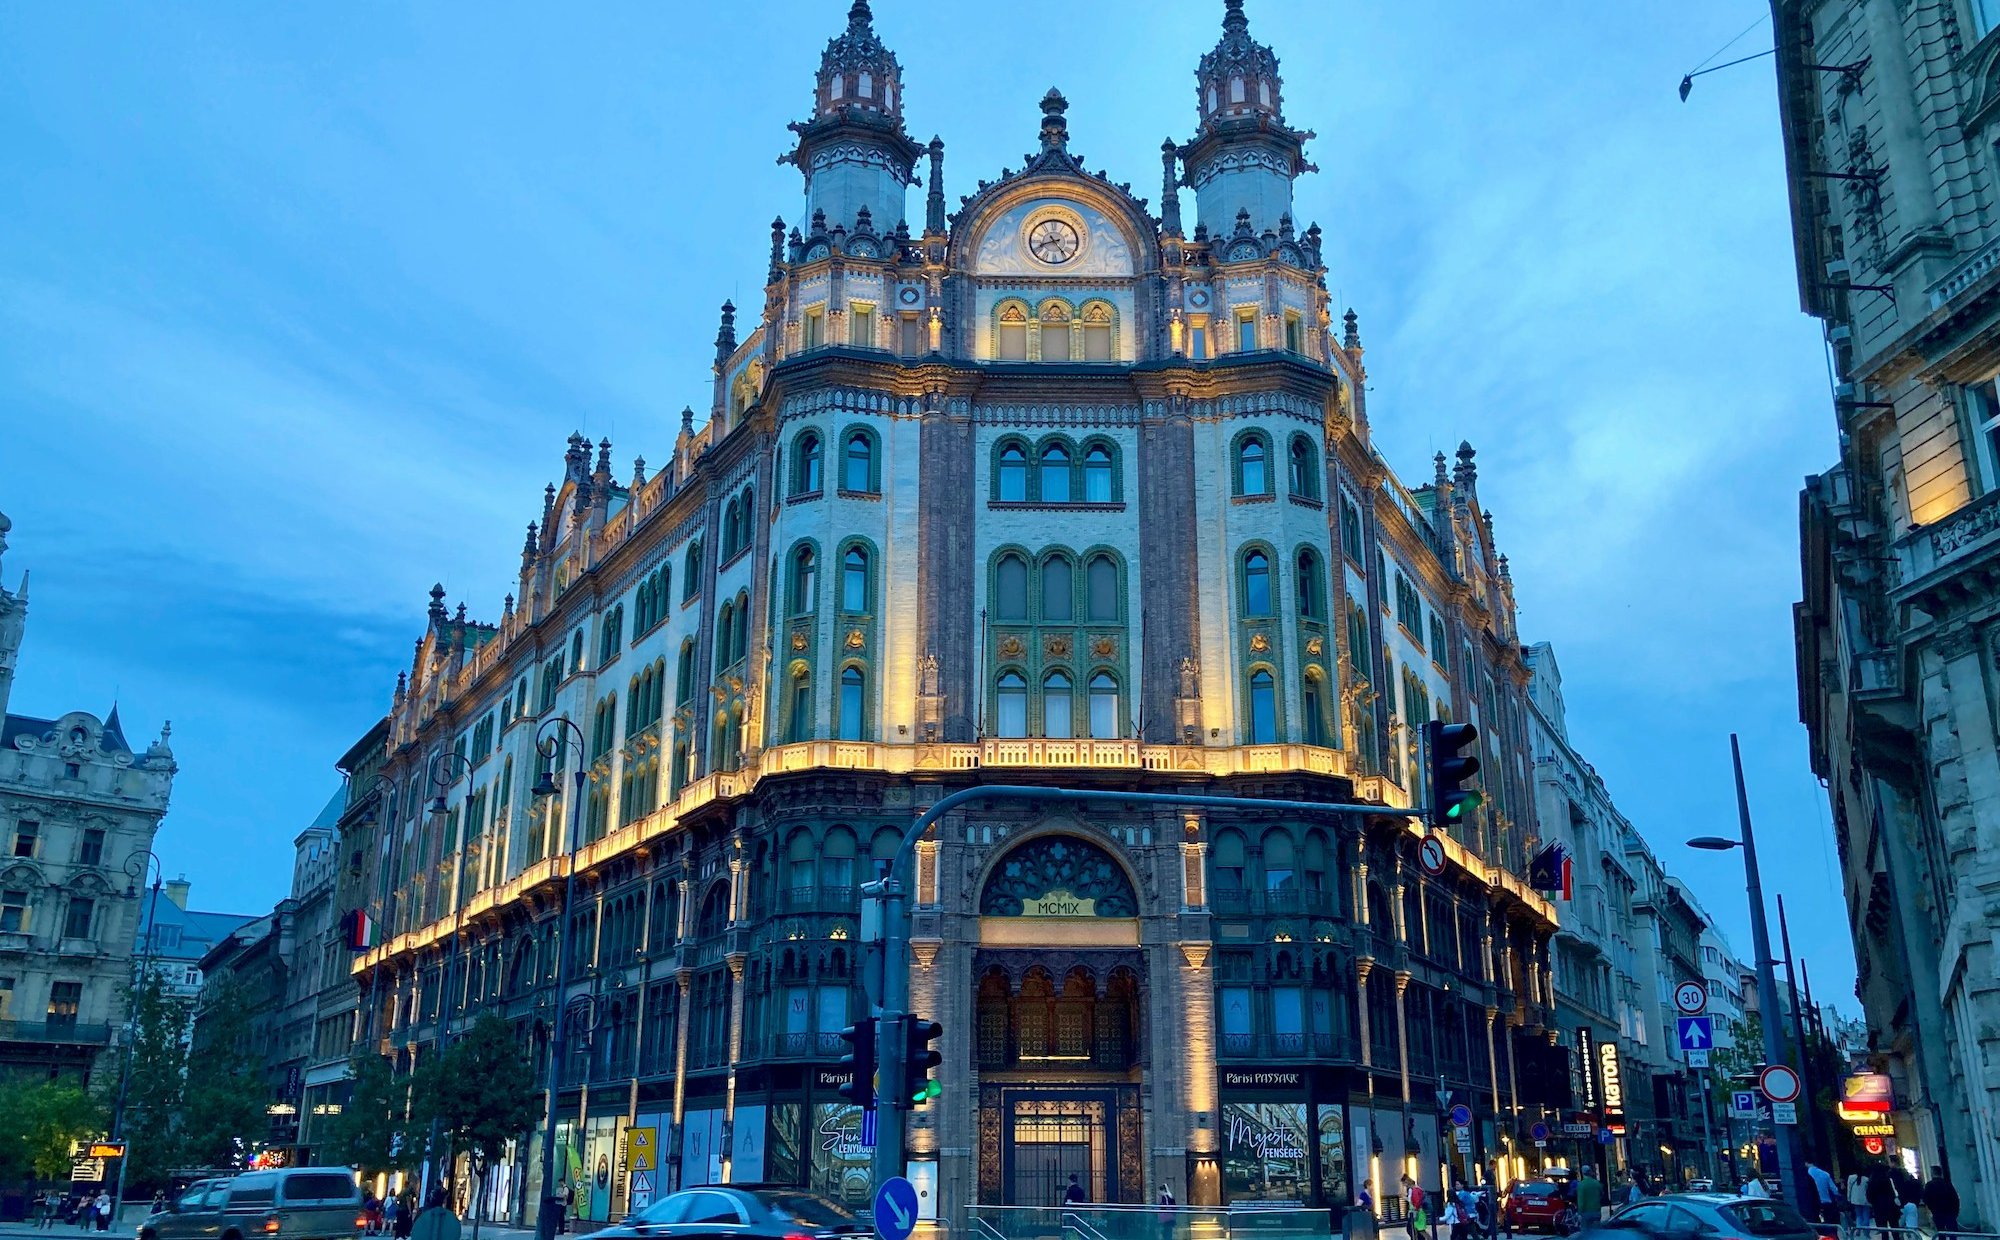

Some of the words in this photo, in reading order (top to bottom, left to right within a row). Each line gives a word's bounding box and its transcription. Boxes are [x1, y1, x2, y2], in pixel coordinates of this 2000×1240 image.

[1038, 903, 1079, 914] MCMIX
[1683, 992, 1700, 1004] 30
[820, 1072, 848, 1083] Párisi
[1226, 1073, 1253, 1084] Párisi
[1255, 1073, 1299, 1084] PASSAGE
[1738, 1095, 1750, 1109] P
[820, 1116, 863, 1151] Stun
[1229, 1114, 1297, 1158] Majestic
[1602, 1131, 1610, 1141] P
[1854, 1125, 1895, 1136] CHANGE
[1264, 1146, 1304, 1158] FENSÉGES
